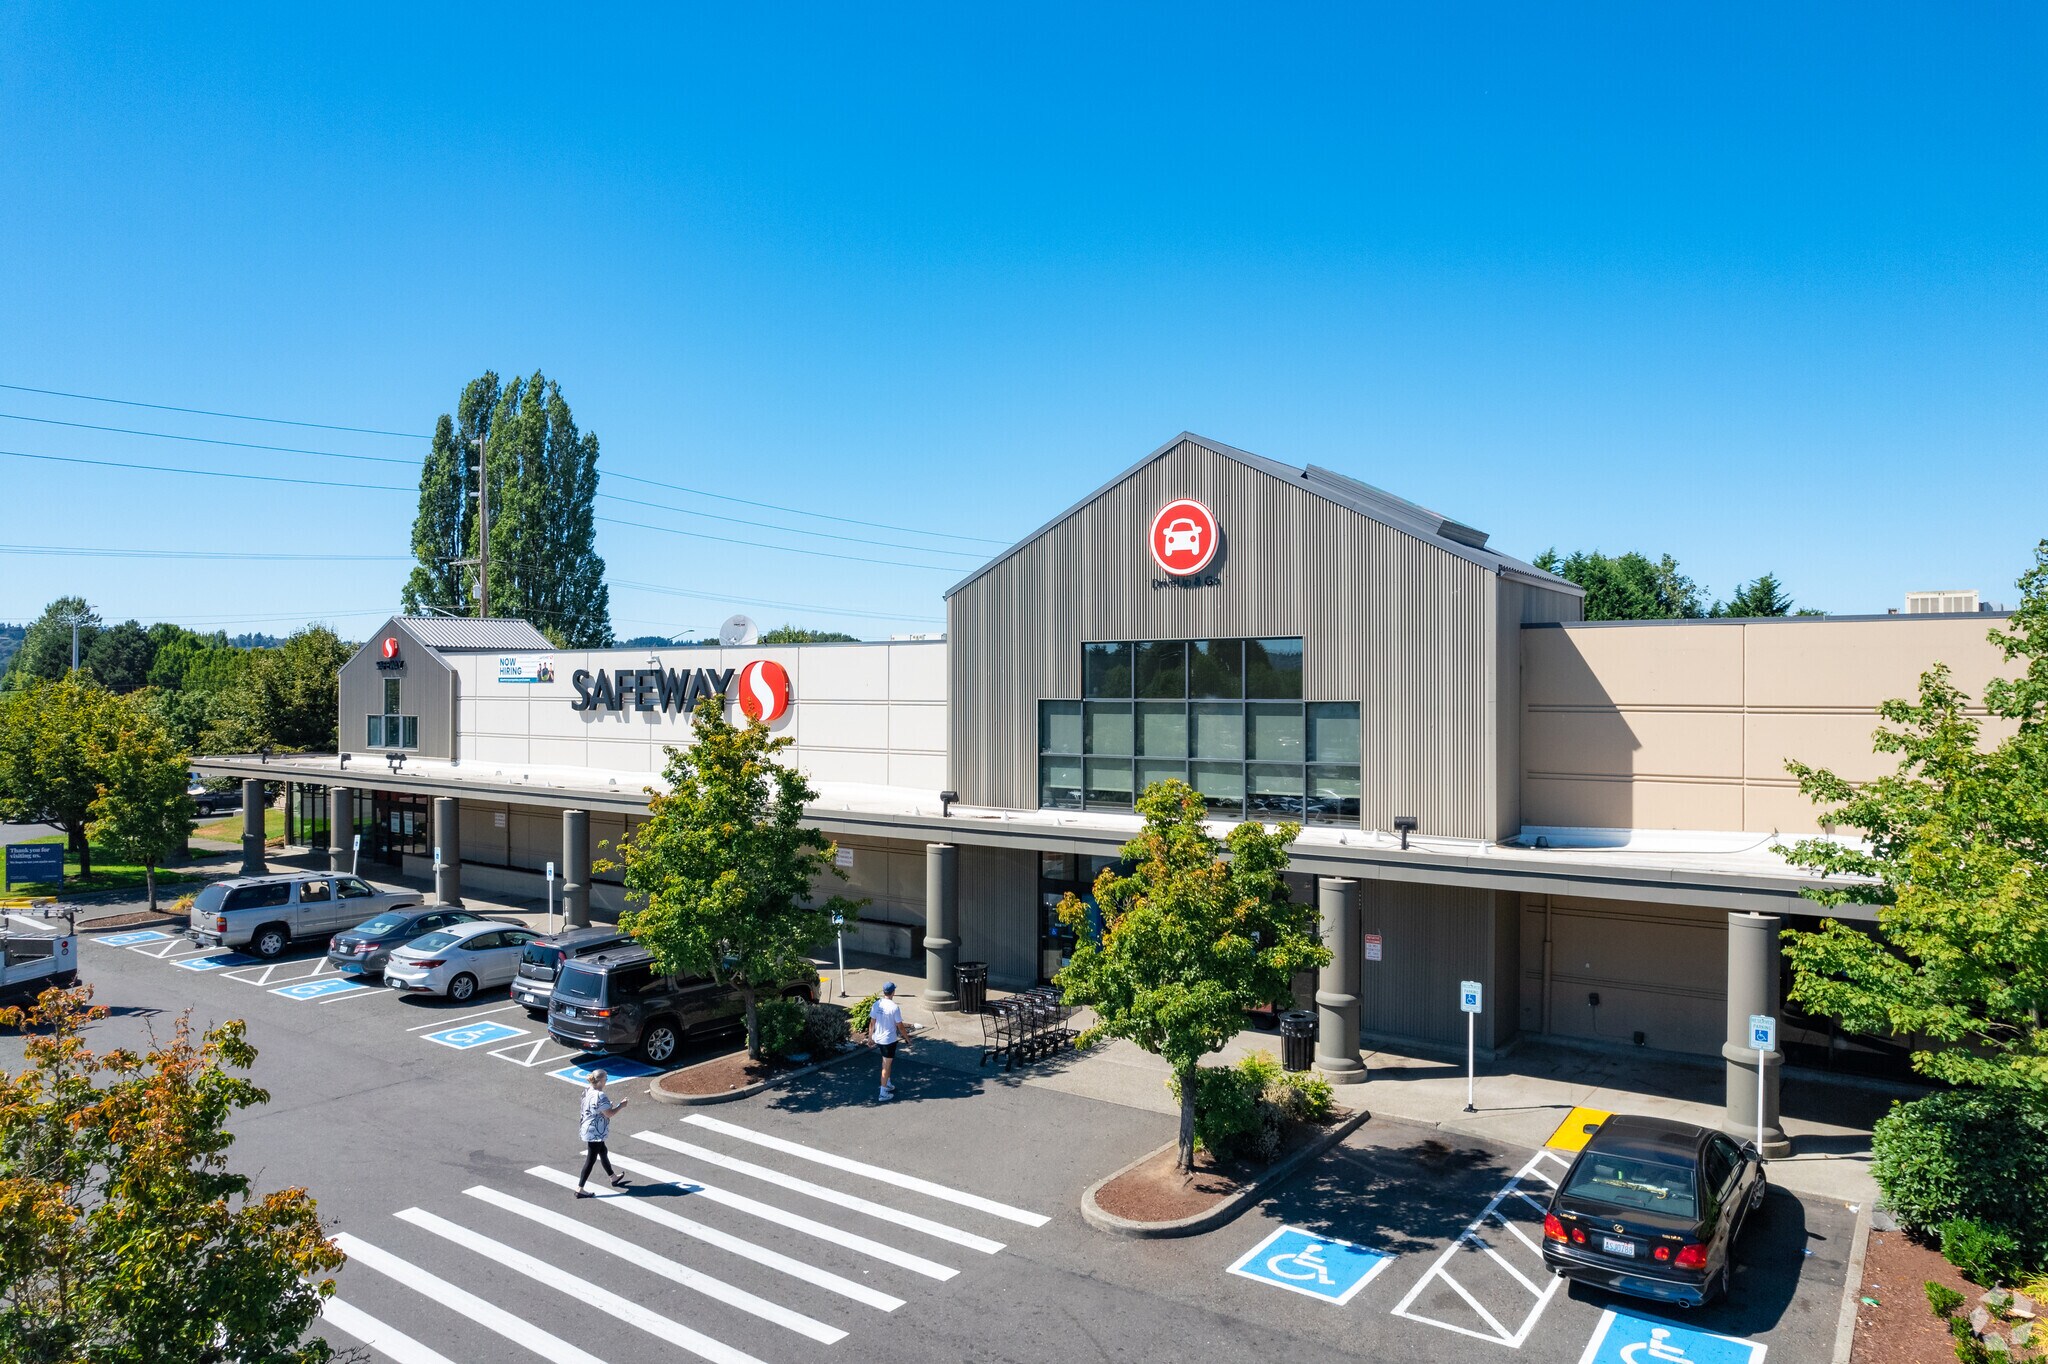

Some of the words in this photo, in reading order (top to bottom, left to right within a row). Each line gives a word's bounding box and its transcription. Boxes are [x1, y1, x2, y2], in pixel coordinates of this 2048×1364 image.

[1205, 575, 1221, 586] Go
[499, 658, 516, 666] NOW
[499, 667, 522, 675] HIRING
[572, 667, 735, 714] SAFEWAY
